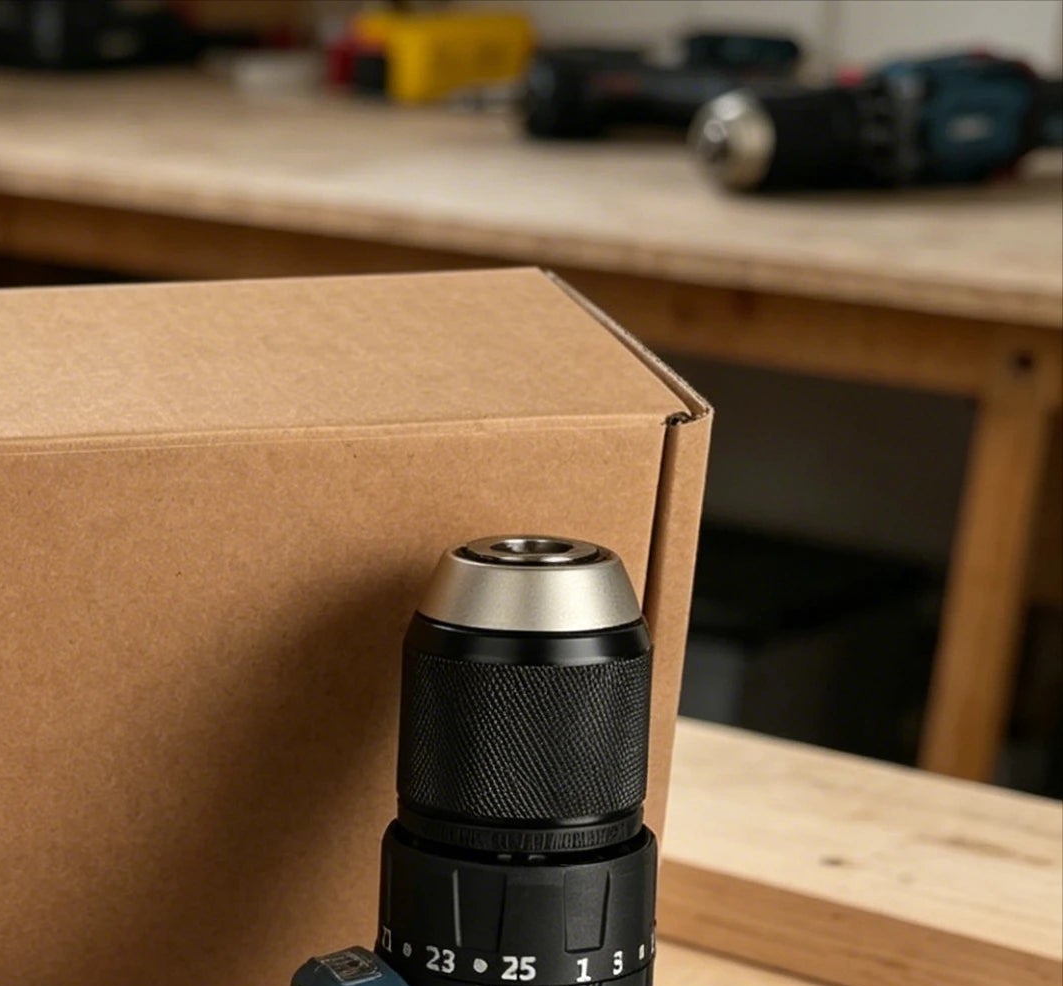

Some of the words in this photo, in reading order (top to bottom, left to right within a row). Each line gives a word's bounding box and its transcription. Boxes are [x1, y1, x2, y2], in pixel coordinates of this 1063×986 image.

[426, 946, 455, 974] 23
[501, 956, 536, 981] 25
[576, 958, 592, 982] 1
[613, 951, 623, 975] 3
